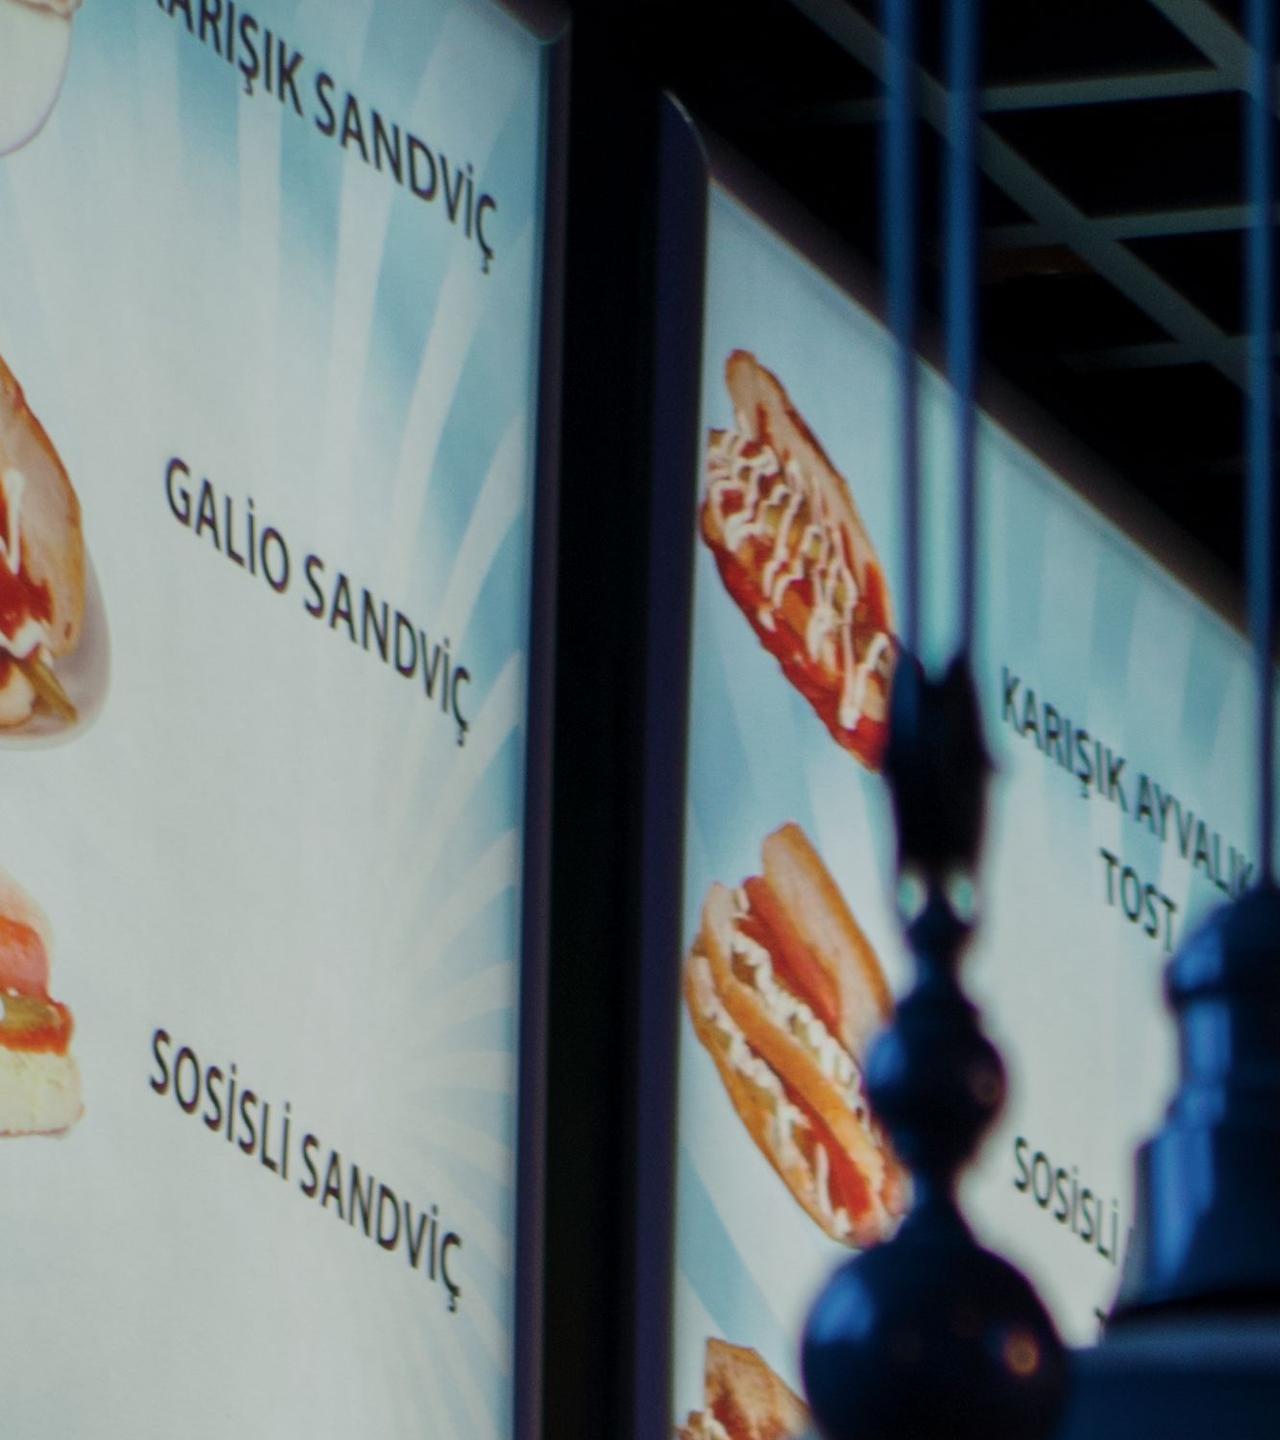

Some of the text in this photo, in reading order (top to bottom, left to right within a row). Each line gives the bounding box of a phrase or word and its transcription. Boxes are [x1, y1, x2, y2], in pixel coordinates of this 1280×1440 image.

[157, 0, 498, 274] RIŞIK SANDVİÇ
[165, 457, 471, 747] GALİO SANDVİÇ
[1001, 666, 1129, 813] KARIŞIK
[1098, 846, 1177, 953] TOST
[149, 1028, 462, 1312] SOSİSLİ SANDVİÇ
[1013, 1136, 1120, 1267] SOSİSLİ
